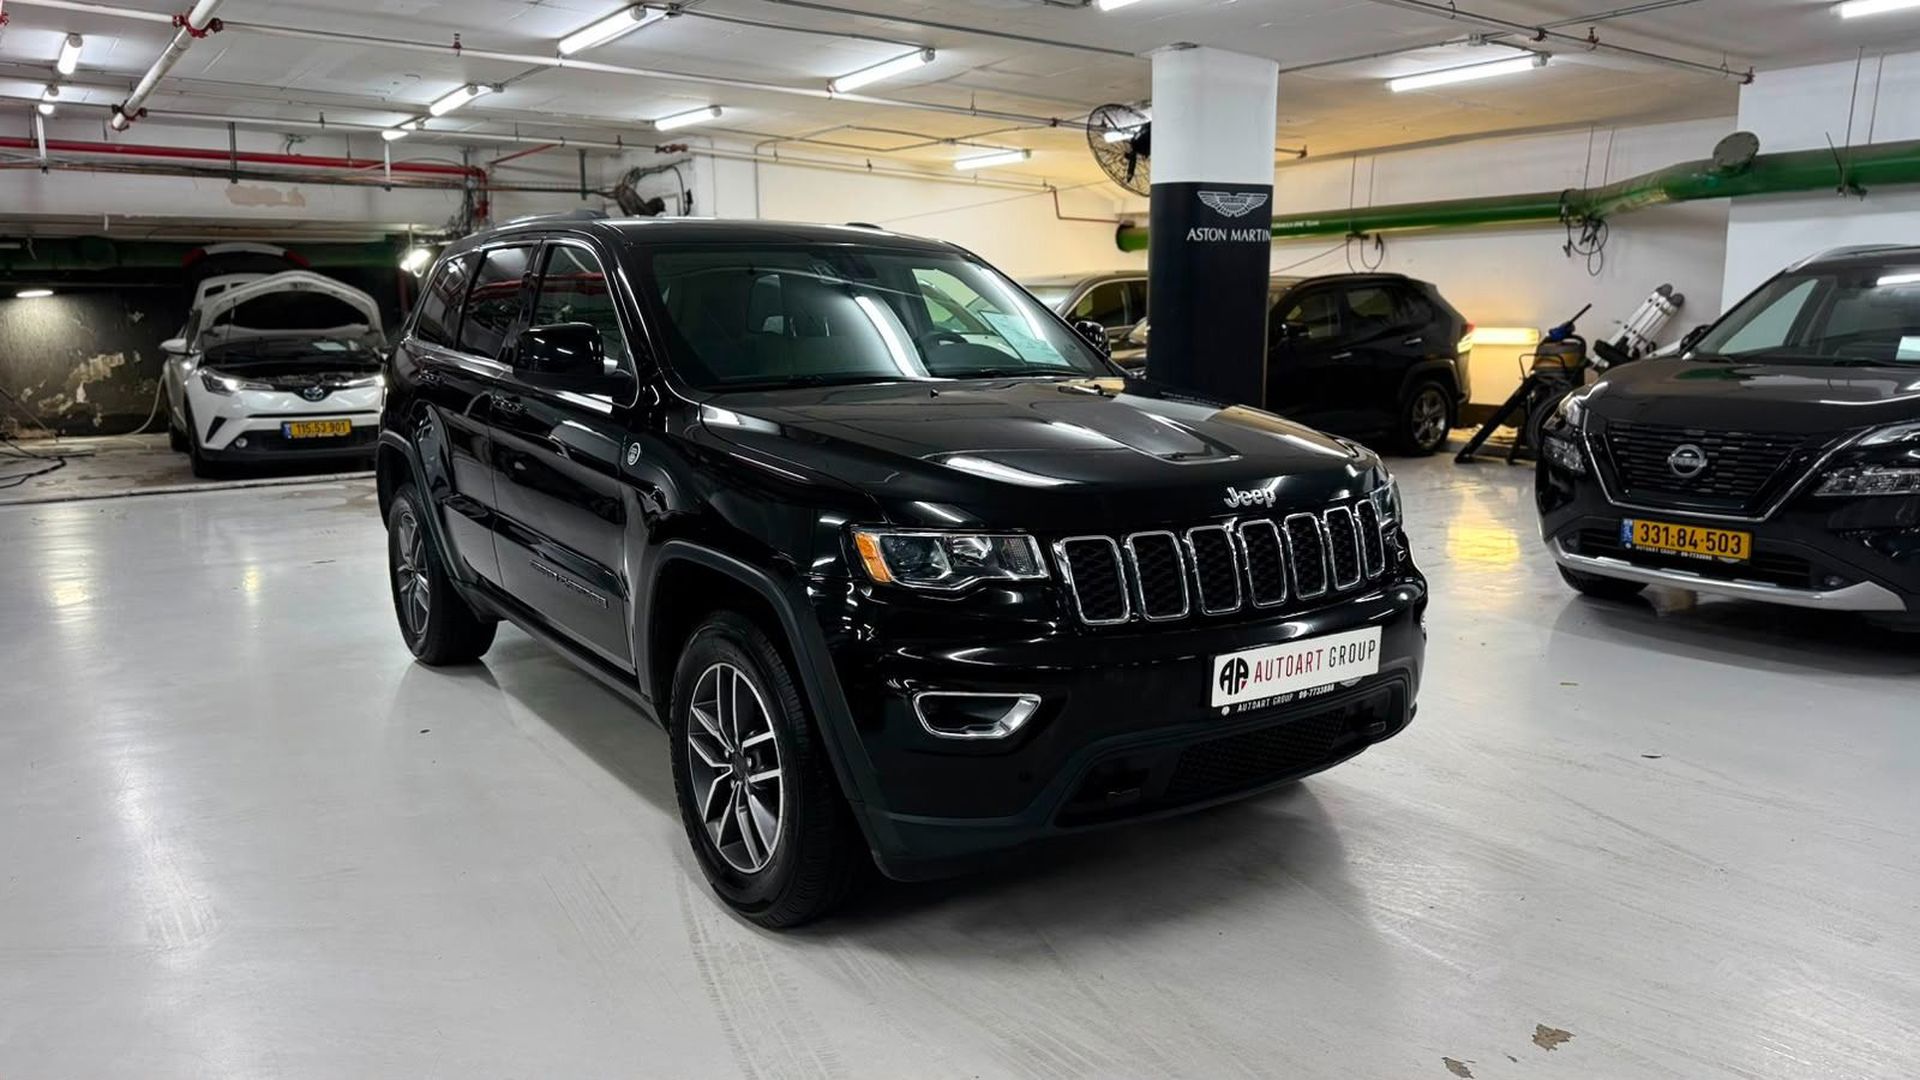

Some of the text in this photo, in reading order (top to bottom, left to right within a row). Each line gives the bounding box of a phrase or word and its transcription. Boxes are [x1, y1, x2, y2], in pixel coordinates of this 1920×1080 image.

[1186, 228, 1271, 242] ASTON MARTIN
[1223, 486, 1277, 508] Jeep
[1254, 639, 1376, 684] AUTOART GROUP
[1236, 698, 1270, 712] AUTOART
[1272, 693, 1294, 705] GROUP
